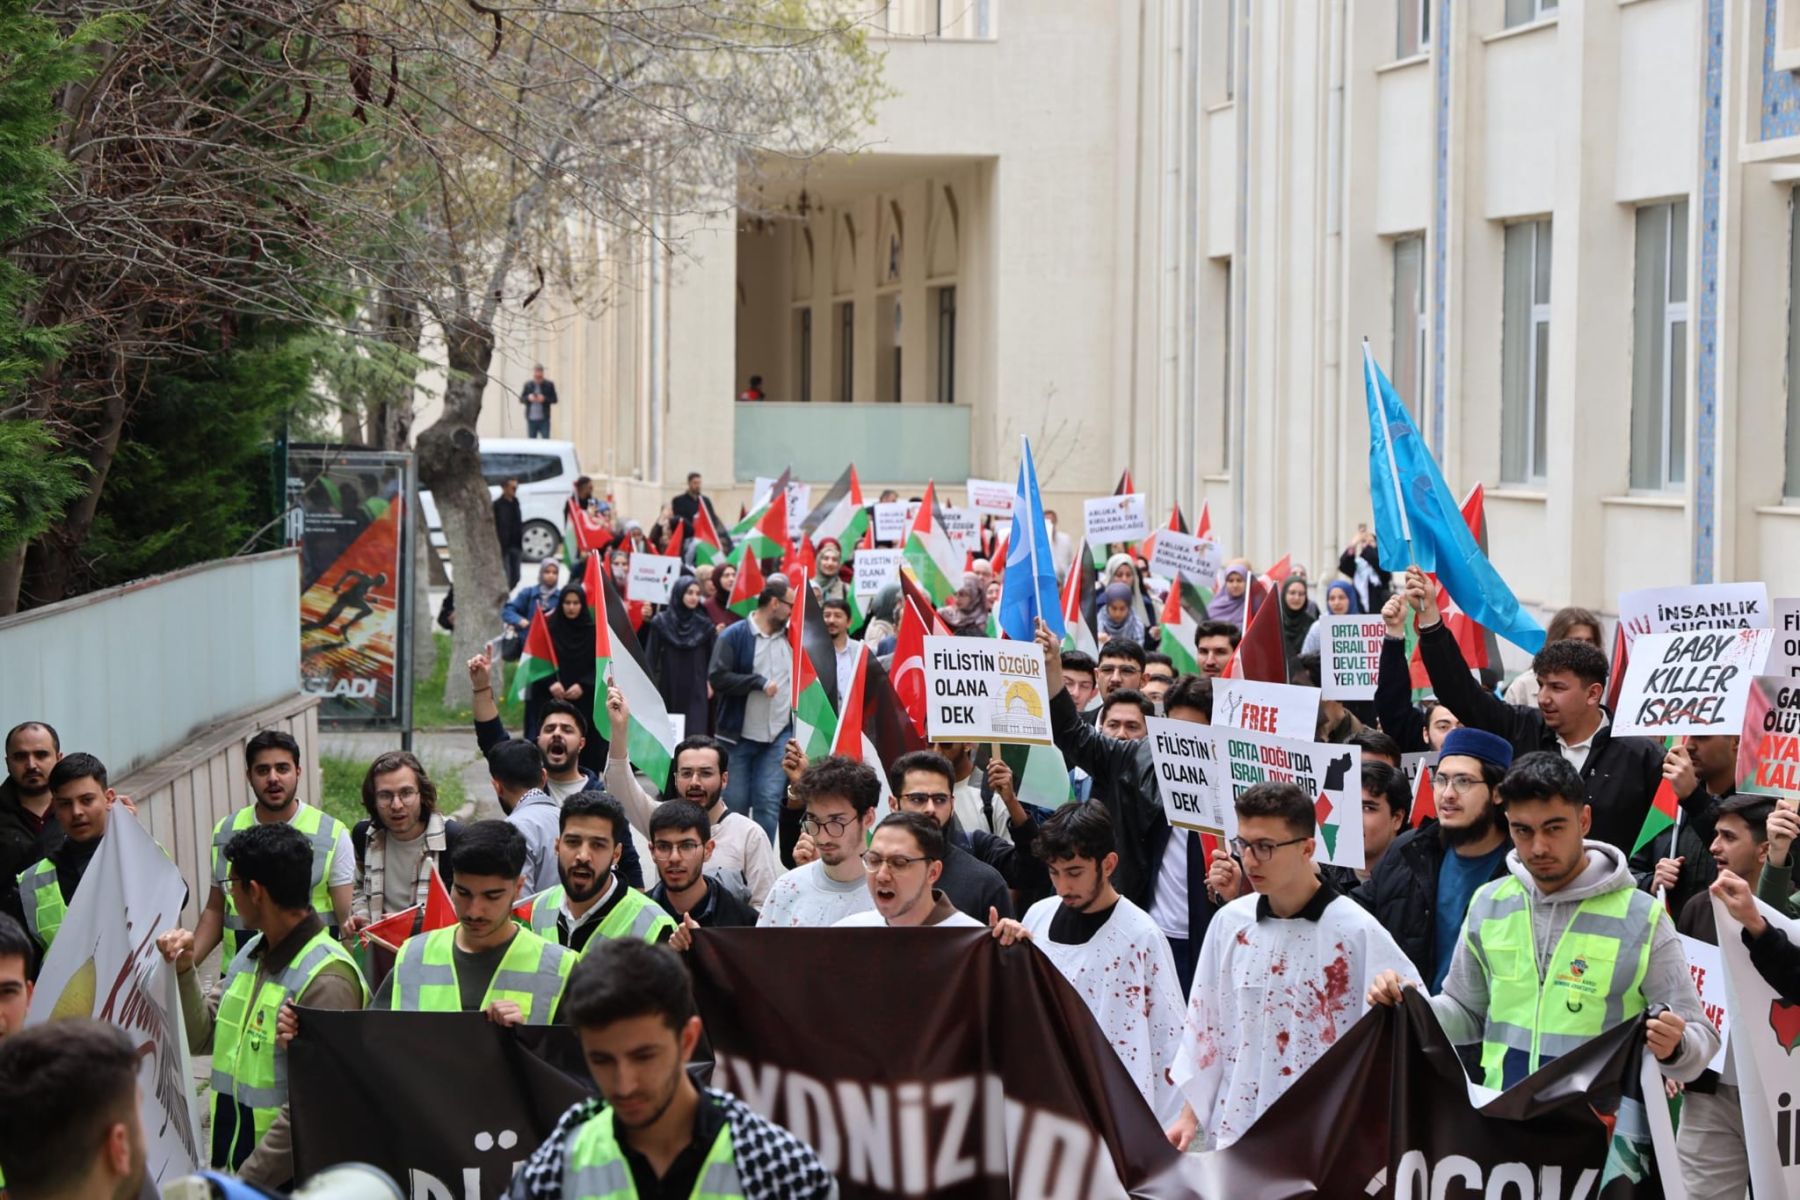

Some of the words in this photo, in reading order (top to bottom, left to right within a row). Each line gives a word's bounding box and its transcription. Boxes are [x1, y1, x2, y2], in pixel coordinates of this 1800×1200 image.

[1658, 601, 1759, 622] İNSANLIK
[1332, 624, 1360, 638] ORTA
[1662, 634, 1736, 664] BABY
[934, 648, 995, 672] FİLİSTİN
[997, 650, 1040, 676] ÖZGÜR
[1333, 656, 1380, 670] DEVLETE
[935, 678, 988, 697] OLANA
[1334, 672, 1354, 686] YER
[1356, 672, 1379, 686] YOK
[1643, 665, 1739, 694] KILLER
[941, 705, 975, 724] DEK
[1240, 702, 1279, 734] FREE
[1635, 696, 1726, 727] ISRAEL
[1156, 731, 1210, 761] FİLİSTİN
[1228, 739, 1260, 762] ORTA
[1260, 745, 1313, 774] DOĞU'DA
[1162, 762, 1209, 787] OLANA
[1171, 791, 1201, 814] DEK
